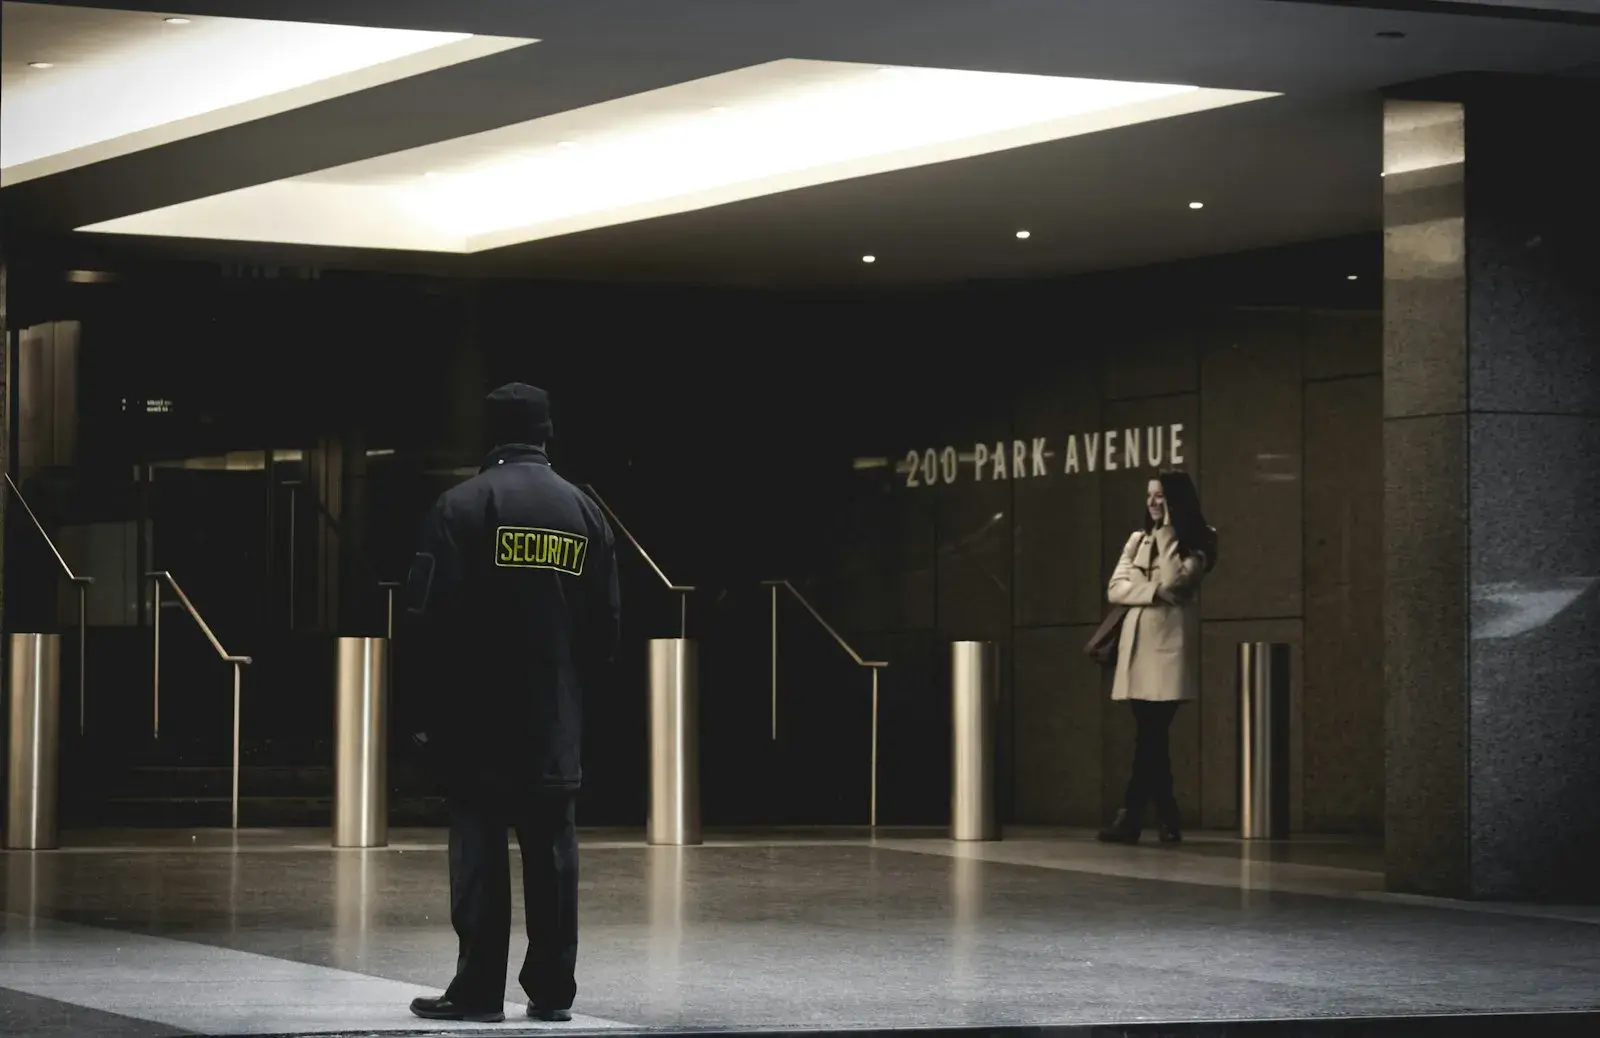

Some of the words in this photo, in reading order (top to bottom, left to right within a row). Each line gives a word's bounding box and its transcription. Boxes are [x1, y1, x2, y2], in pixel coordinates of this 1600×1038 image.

[905, 446, 958, 488] 200
[974, 436, 1047, 482] PARK
[1063, 423, 1185, 475] AVENUE
[500, 532, 585, 570] SECURITY
